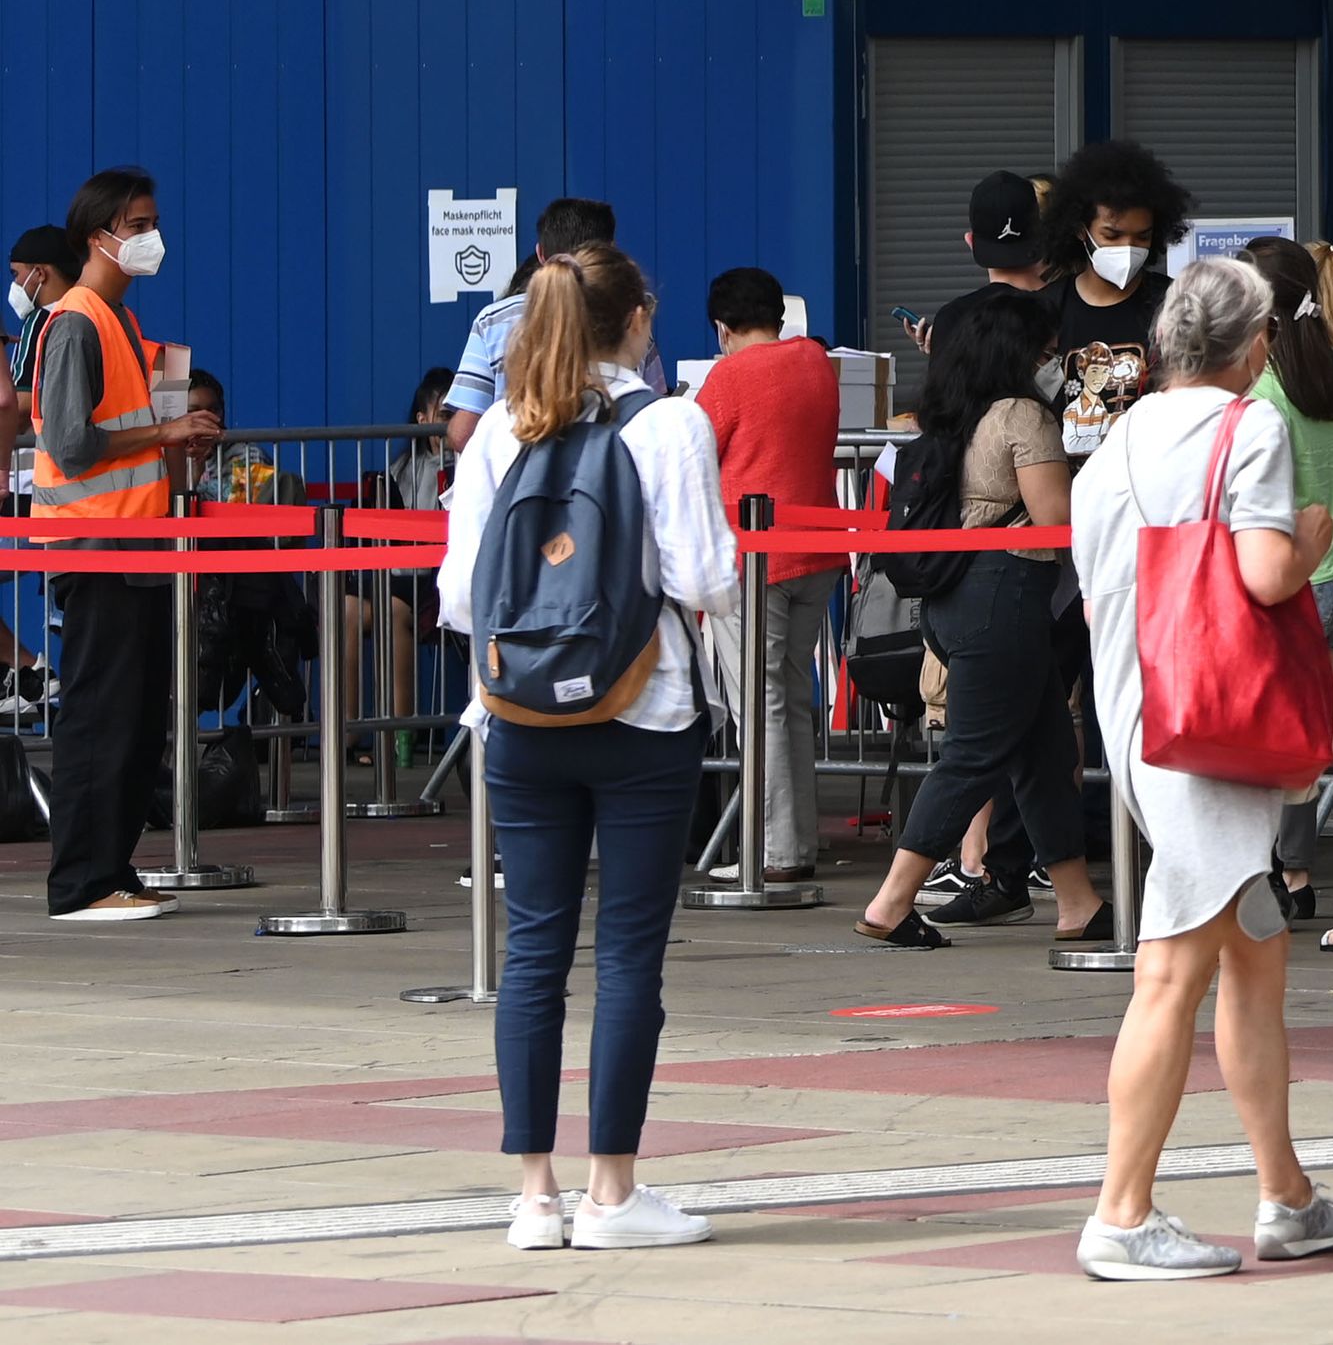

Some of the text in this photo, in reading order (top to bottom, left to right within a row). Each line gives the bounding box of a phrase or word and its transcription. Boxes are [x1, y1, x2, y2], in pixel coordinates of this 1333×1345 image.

[443, 210, 502, 222] Maskenpflicht
[432, 224, 514, 237] face mask required
